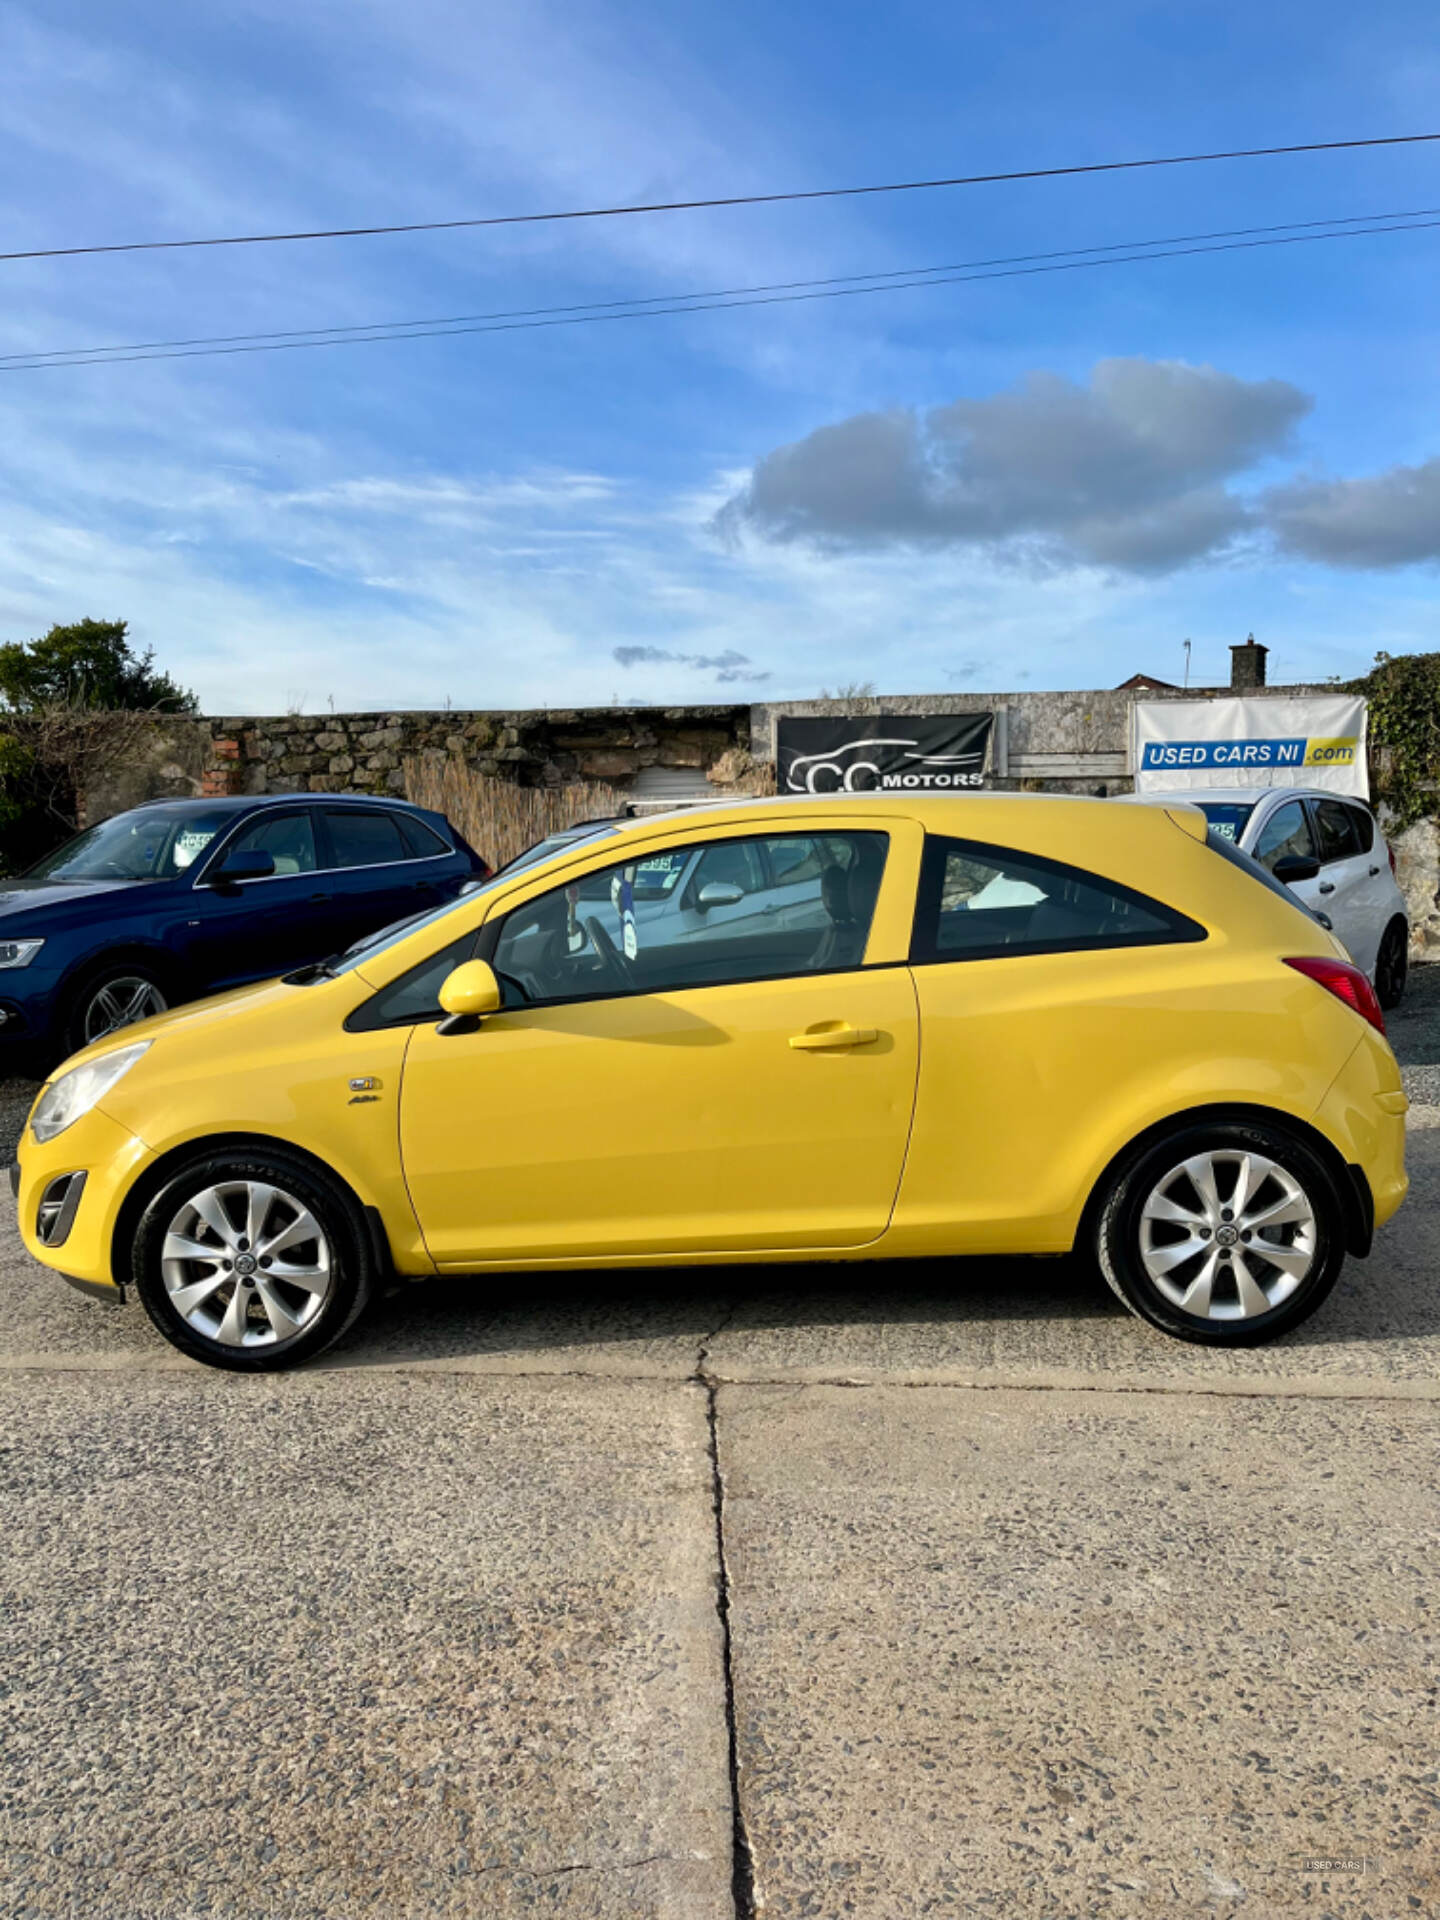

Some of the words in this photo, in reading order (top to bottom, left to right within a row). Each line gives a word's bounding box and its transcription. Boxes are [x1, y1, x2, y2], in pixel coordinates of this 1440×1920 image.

[1150, 748, 1206, 764] USED
[1213, 746, 1271, 763] CARS
[1277, 745, 1299, 760] NI
[1307, 746, 1353, 760] .com
[883, 773, 984, 787] MOTORS
